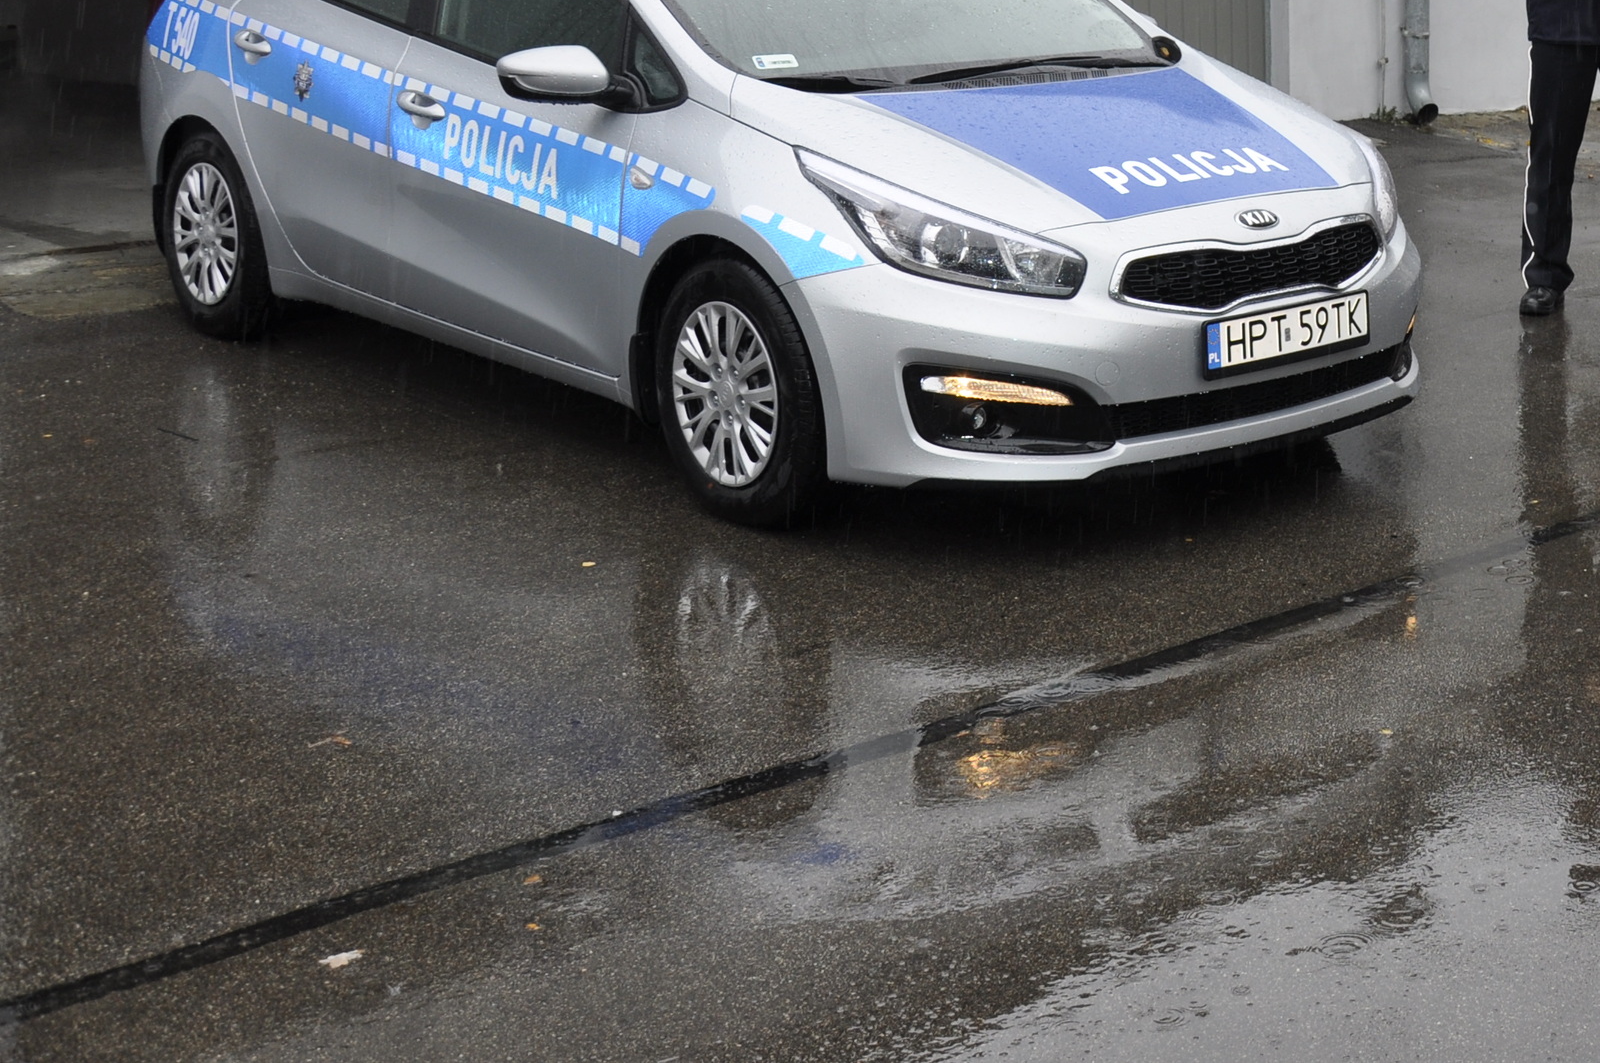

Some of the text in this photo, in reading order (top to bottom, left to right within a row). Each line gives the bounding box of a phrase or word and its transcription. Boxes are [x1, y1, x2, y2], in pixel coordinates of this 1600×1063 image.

[163, 0, 200, 60] T 540
[443, 113, 558, 200] POLICJA
[1088, 147, 1290, 195] POLICJA
[1241, 211, 1276, 226] KIA
[1226, 298, 1362, 363] HPT 59TK
[1208, 352, 1220, 364] PL
